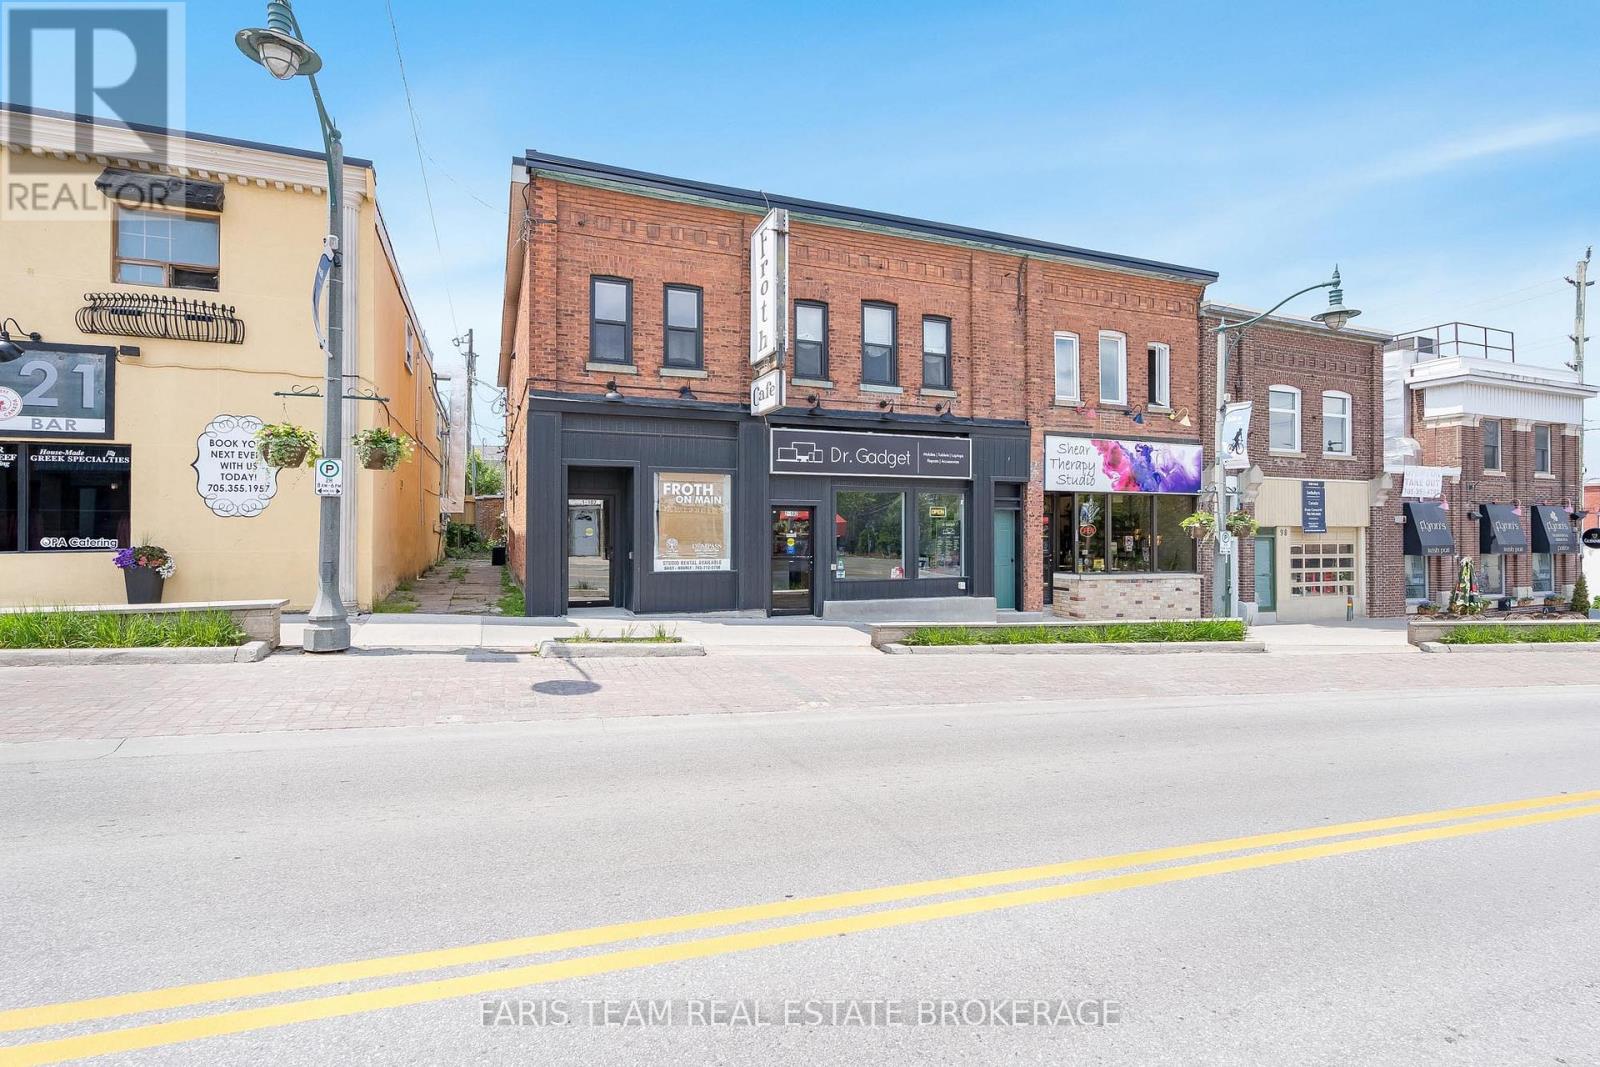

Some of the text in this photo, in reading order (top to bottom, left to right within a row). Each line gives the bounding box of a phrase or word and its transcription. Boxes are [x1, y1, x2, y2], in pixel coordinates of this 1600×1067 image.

[758, 227, 769, 353] Froth
[20, 361, 95, 409] 21
[753, 381, 775, 407] Cafe
[31, 418, 77, 431] BAR
[209, 439, 239, 448] BOOK
[1058, 443, 1090, 456] Shear
[39, 448, 85, 456] House-Made
[210, 450, 258, 459] NEXT EVE
[830, 446, 911, 468] Dr. Gadget
[220, 462, 243, 470] WITH
[1050, 458, 1096, 477] Therapy
[220, 473, 257, 481] TODAY!
[1056, 474, 1096, 486] Studio
[207, 483, 270, 493] 705.355.1957
[663, 482, 714, 496] FROTH
[675, 495, 722, 504] ON MAIN
[40, 537, 118, 549] OPA Catering
